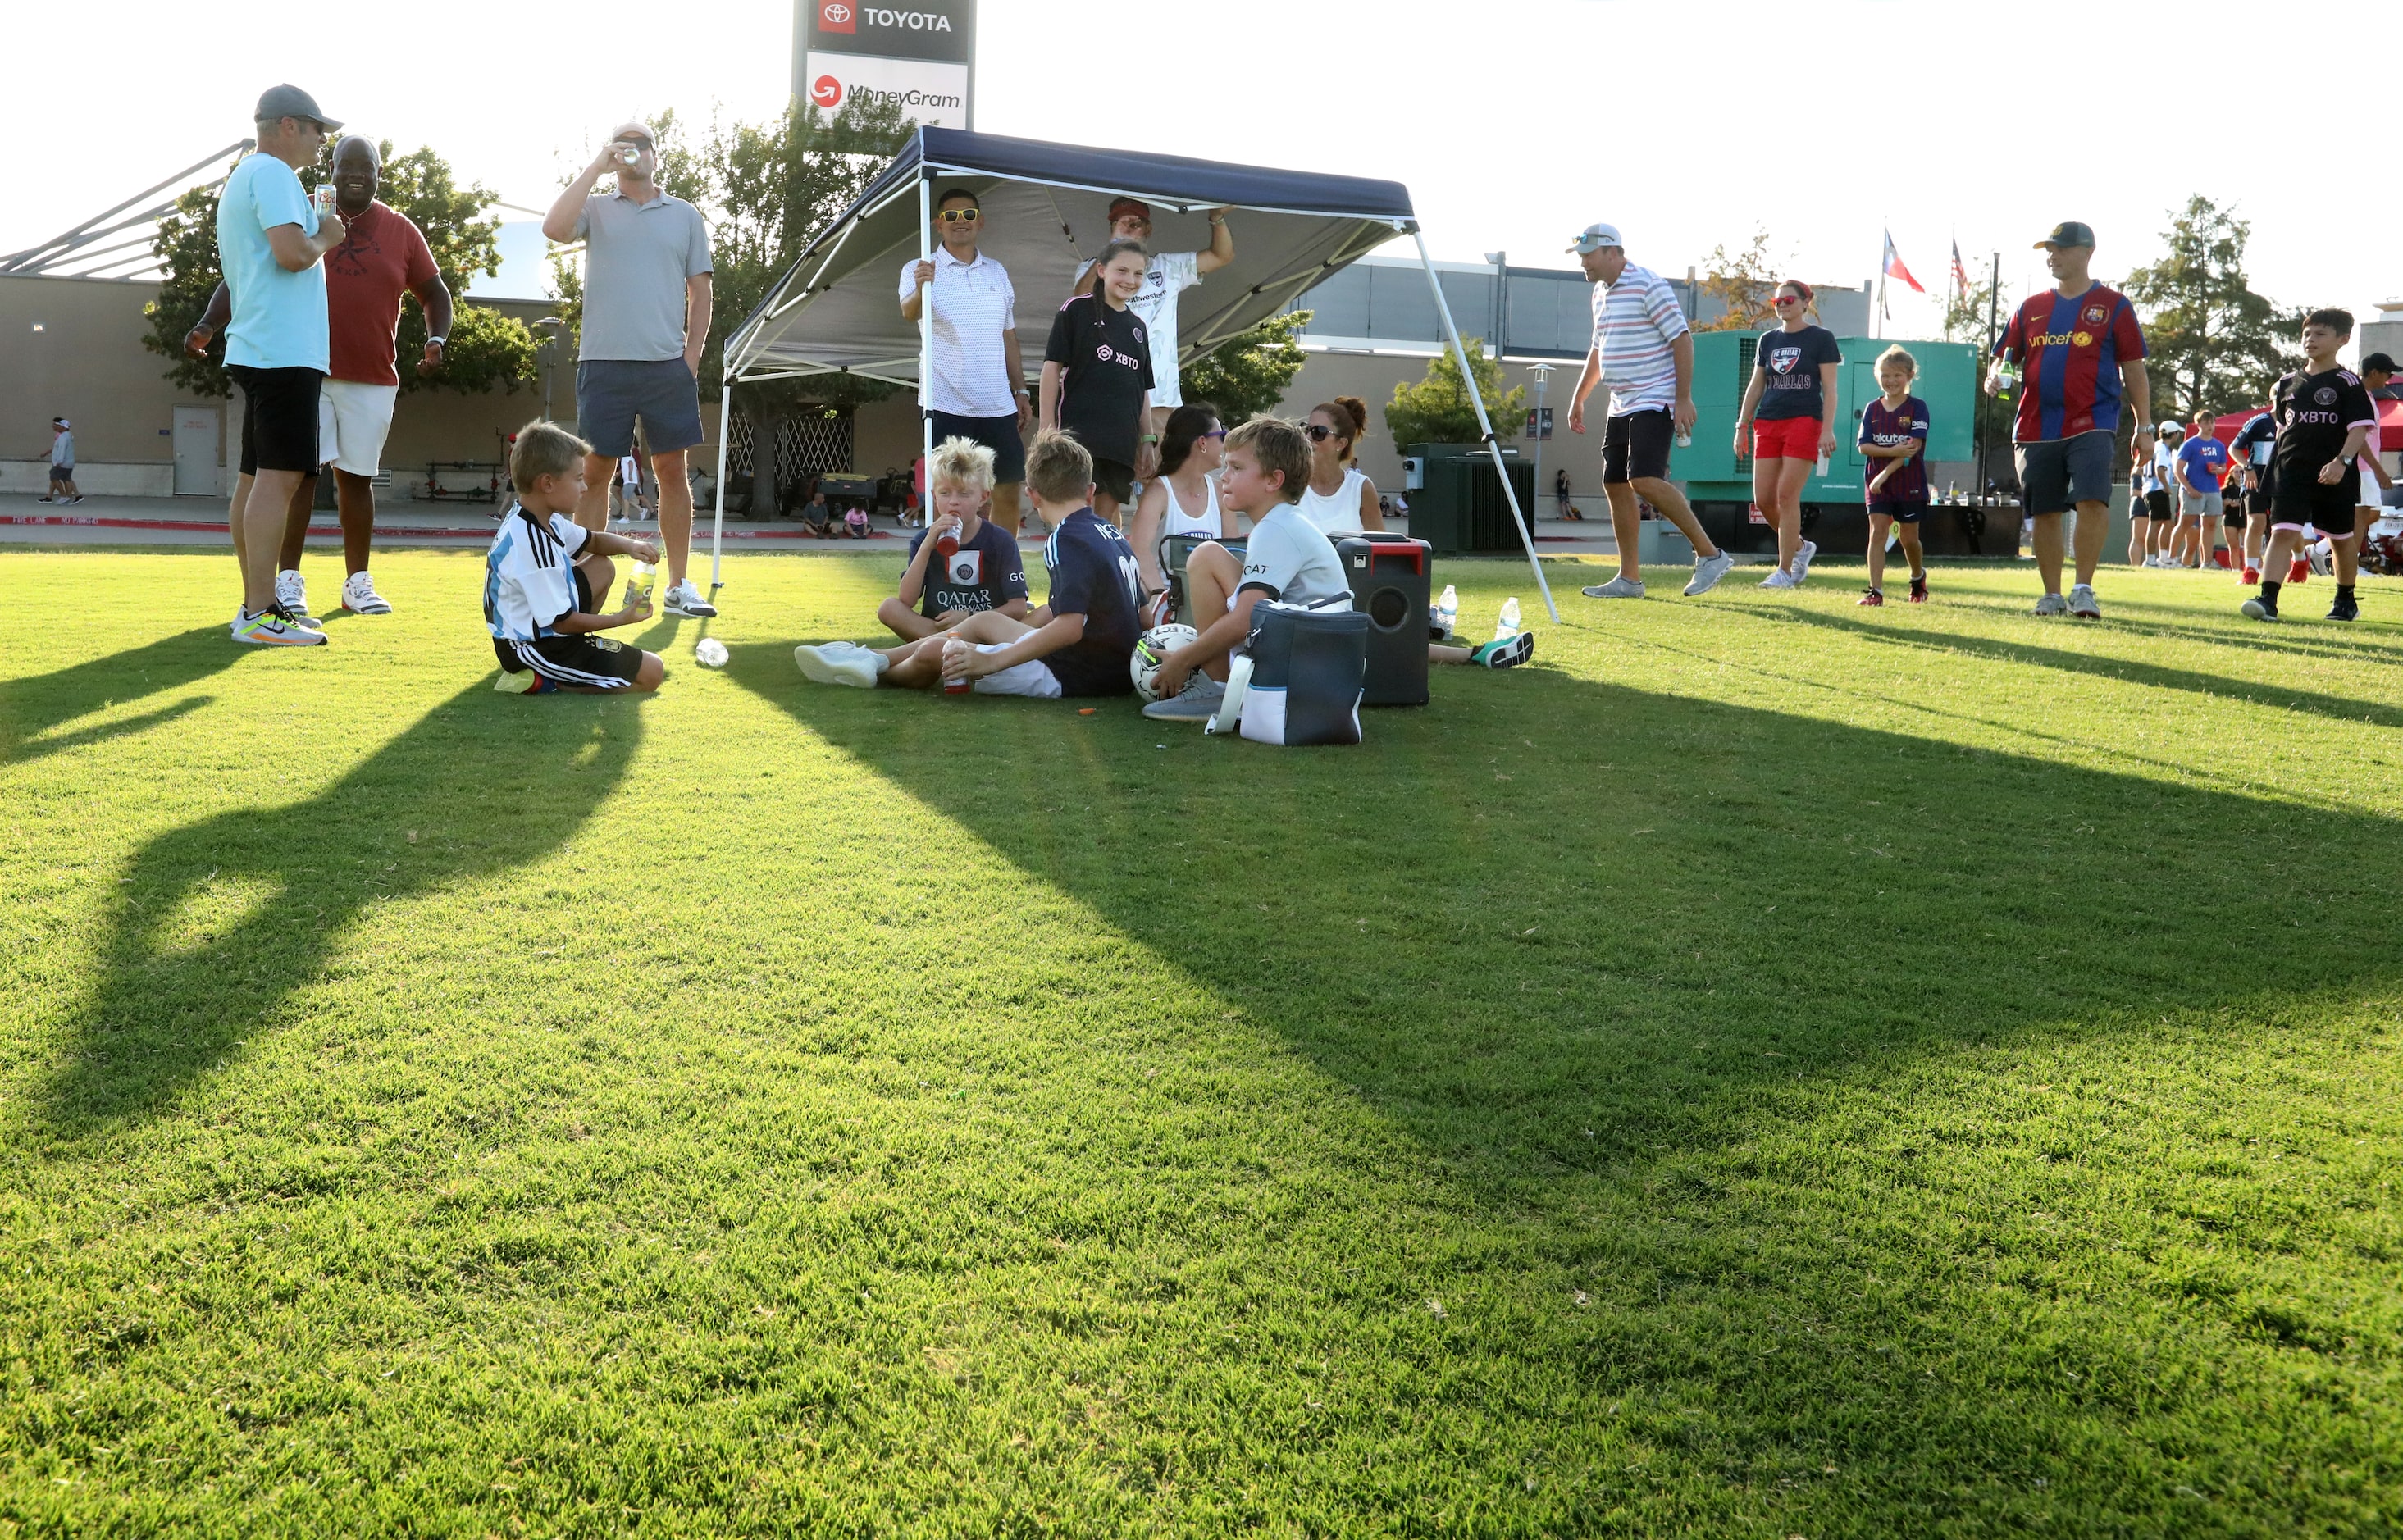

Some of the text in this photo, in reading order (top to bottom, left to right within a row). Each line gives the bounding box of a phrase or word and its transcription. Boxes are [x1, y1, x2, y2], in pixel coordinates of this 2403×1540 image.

[864, 8, 951, 33] TOYOTA
[847, 84, 960, 108] MoneyGram
[1125, 289, 1167, 303] outhwestern
[2028, 330, 2073, 348] unicef
[1115, 351, 1139, 371] XBTO
[1773, 374, 1811, 390] DALLAS
[2298, 411, 2338, 425] XBTO
[2201, 447, 2218, 457] USA
[12, 516, 27, 524] FIRE
[937, 589, 992, 607] QATAR
[949, 601, 992, 612] AIRWAYS
